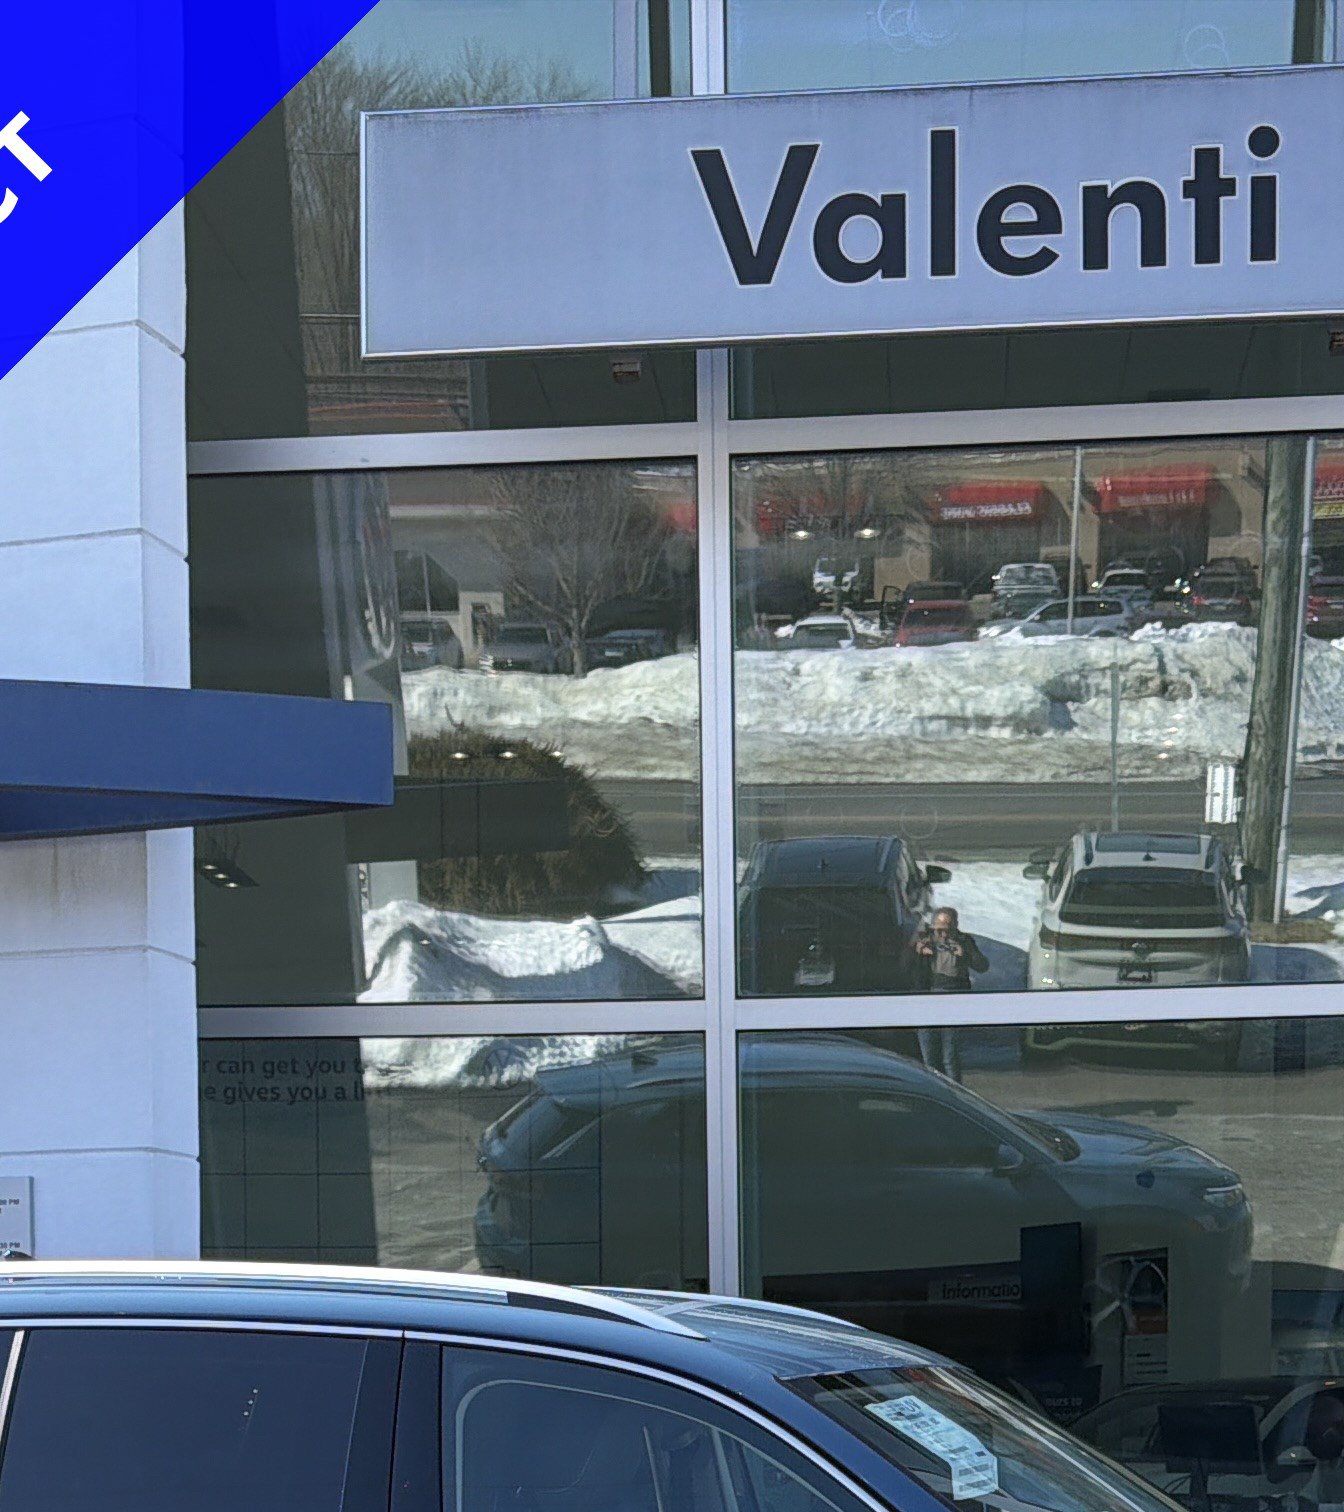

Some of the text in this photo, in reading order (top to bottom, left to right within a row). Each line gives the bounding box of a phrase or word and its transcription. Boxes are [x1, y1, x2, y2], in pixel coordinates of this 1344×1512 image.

[688, 121, 1282, 288] Valenti
[262, 1057, 298, 1079] get
[305, 1059, 346, 1079] you
[222, 1081, 282, 1106] gives
[286, 1085, 327, 1106] you
